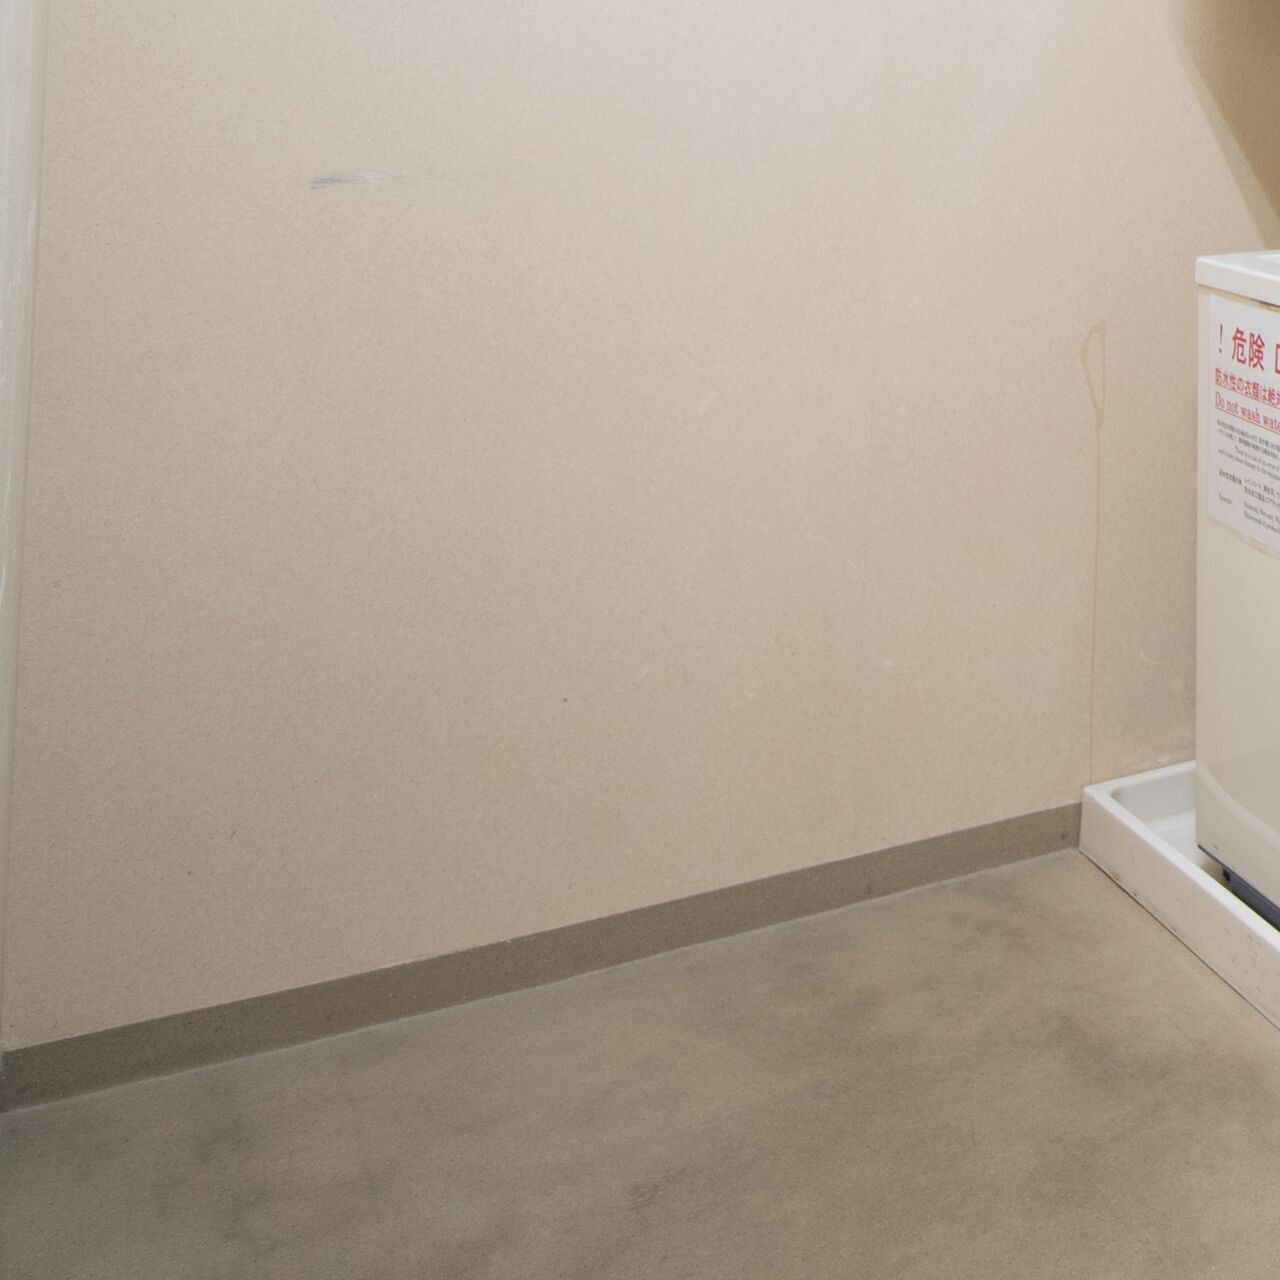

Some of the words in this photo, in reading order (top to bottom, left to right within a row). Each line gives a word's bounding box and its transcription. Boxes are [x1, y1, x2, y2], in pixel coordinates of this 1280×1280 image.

[1231, 326, 1266, 371] 危険
[1214, 391, 1225, 410] Do
[1240, 404, 1261, 425] wash
